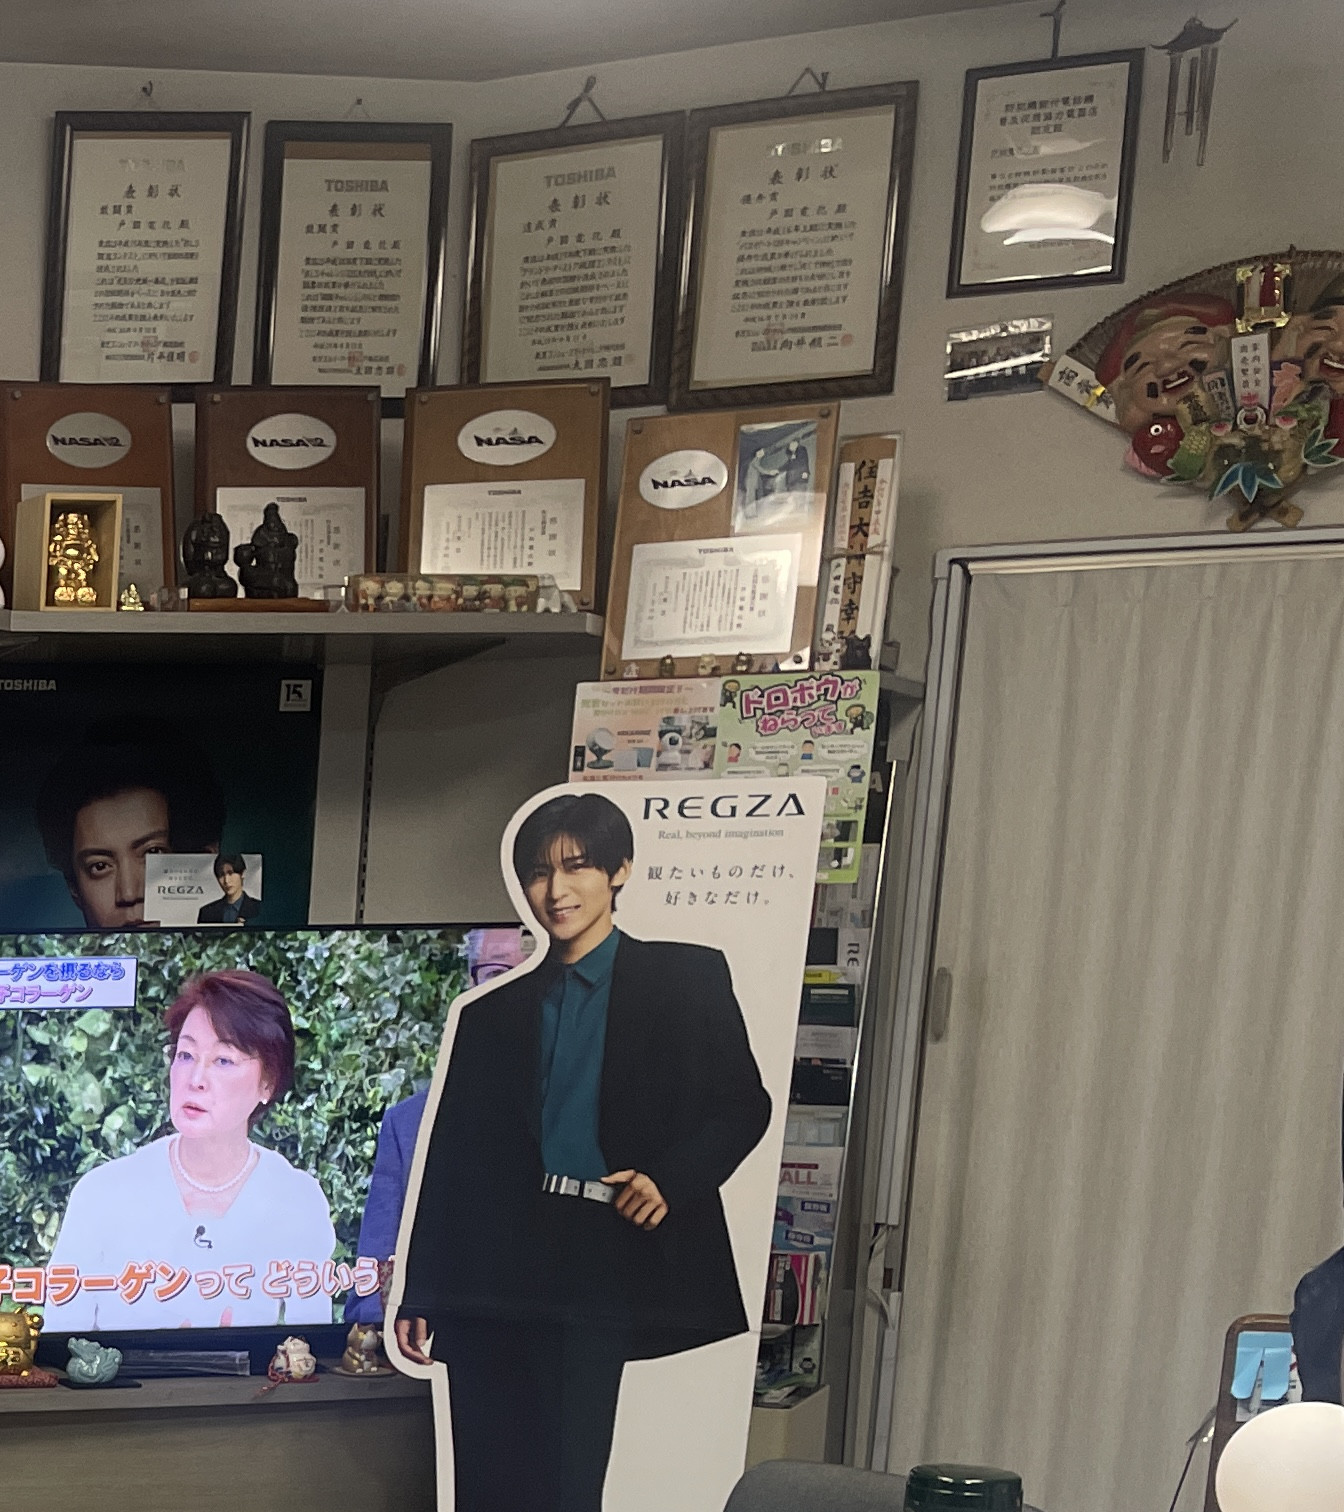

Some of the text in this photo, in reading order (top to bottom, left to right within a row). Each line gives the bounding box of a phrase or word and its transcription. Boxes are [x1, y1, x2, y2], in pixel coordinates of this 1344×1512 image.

[324, 179, 389, 192] TOSHIBA
[543, 166, 617, 188] TOSHIBA
[473, 434, 545, 447] NASA
[651, 476, 717, 492] NASA
[742, 676, 862, 718] ドロボウが
[758, 706, 836, 735] ねらって
[643, 793, 806, 820] REGZA
[658, 827, 784, 841] Real, beyond imagination
[646, 864, 797, 883] 観たいものだけ、
[157, 885, 204, 895] REGZA
[664, 889, 773, 907] 好きなだけ。
